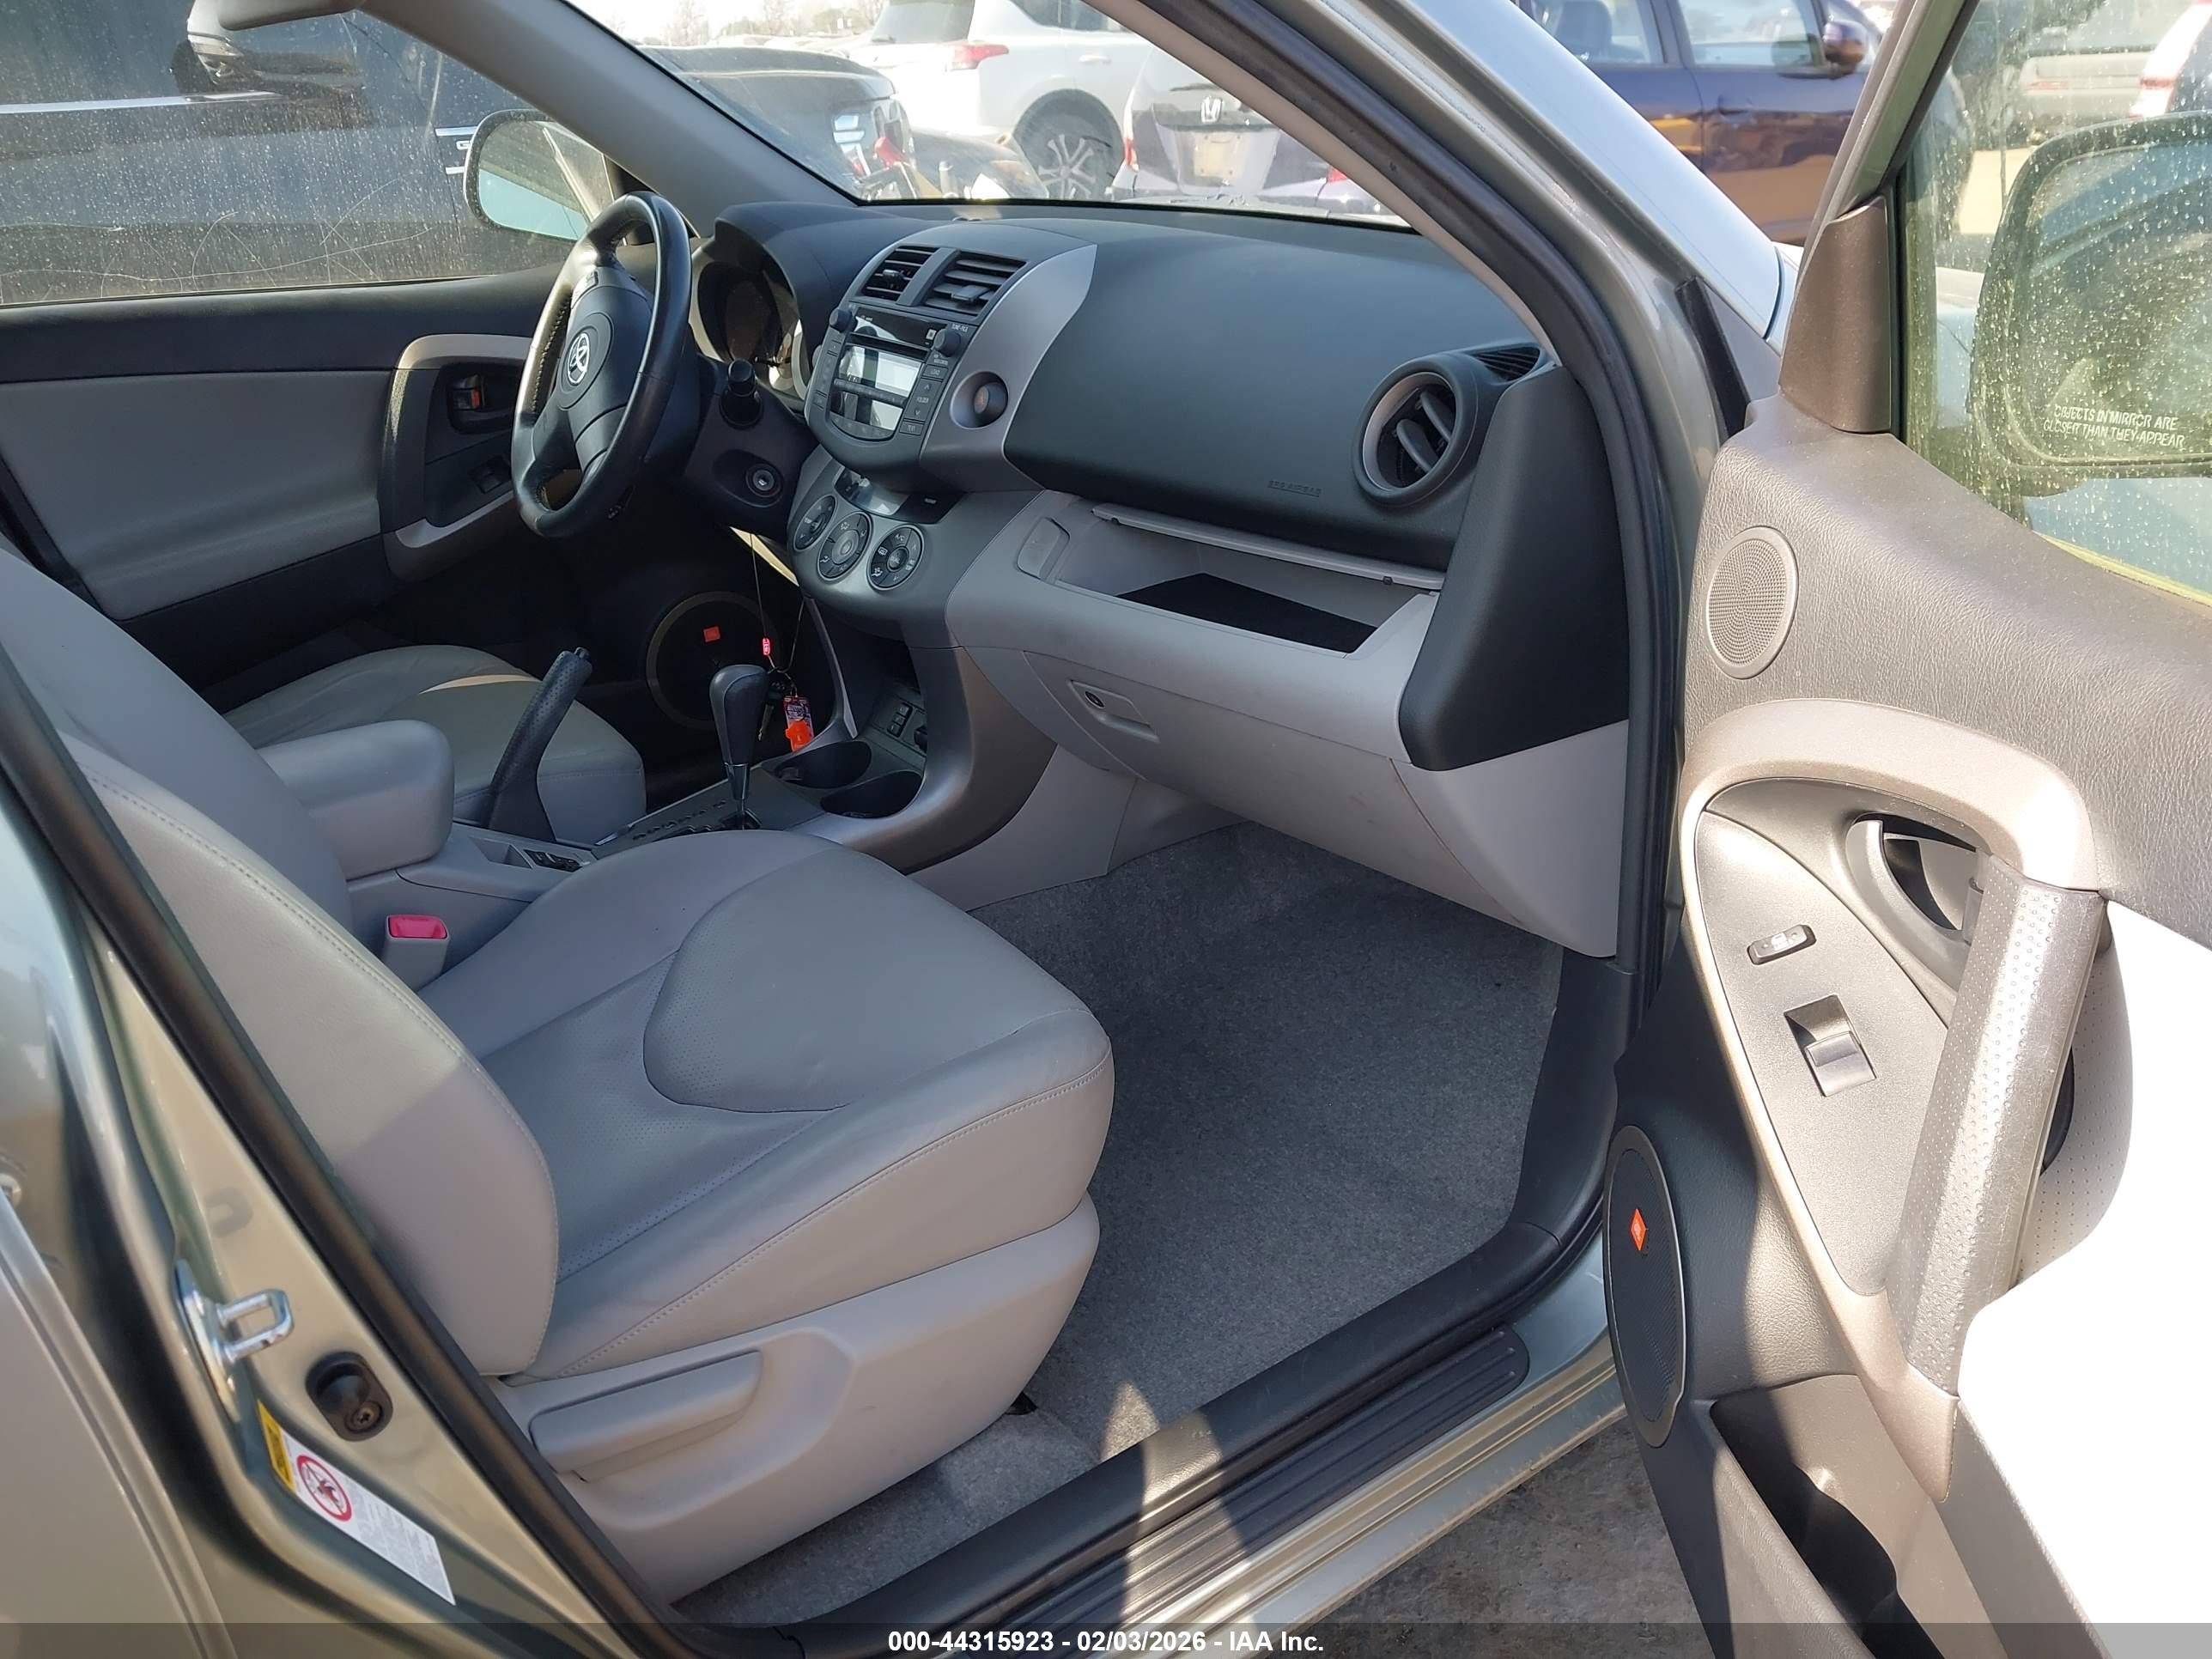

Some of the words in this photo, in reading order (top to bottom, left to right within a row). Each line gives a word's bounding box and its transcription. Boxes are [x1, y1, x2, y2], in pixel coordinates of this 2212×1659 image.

[2053, 404, 2096, 422] OBJECTS
[2097, 410, 2108, 423] IN
[2109, 410, 2152, 428] MIRROR
[2154, 416, 2179, 430] ARE
[2043, 418, 2078, 434] CLOSER
[2081, 422, 2109, 439] THAN
[2111, 427, 2138, 442] THEY
[2138, 431, 2185, 448] APPEAR
